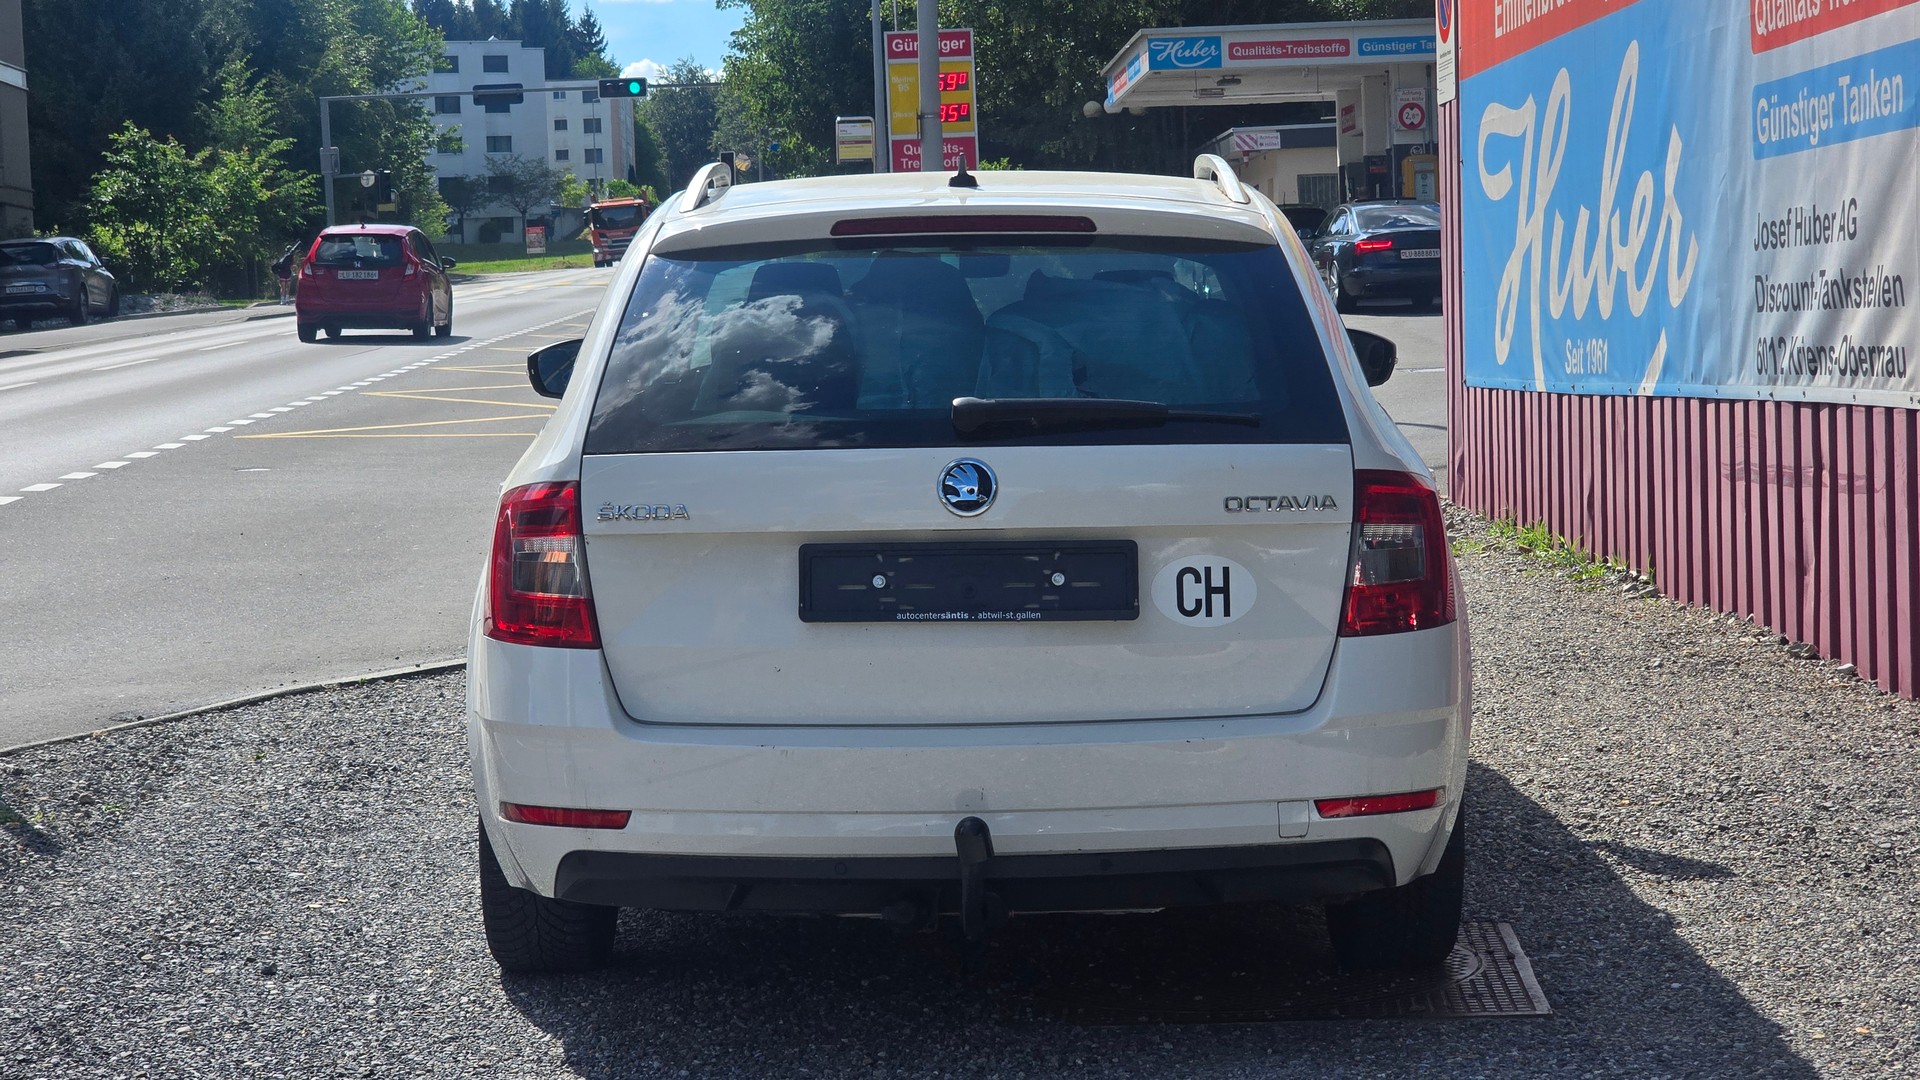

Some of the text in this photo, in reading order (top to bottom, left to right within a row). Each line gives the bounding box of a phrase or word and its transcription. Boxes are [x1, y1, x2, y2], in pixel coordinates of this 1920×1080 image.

[1150, 40, 1219, 67] Huber
[1233, 43, 1346, 56] Qualitäts-Treibstoffe
[1362, 41, 1417, 52] Günstiger
[1757, 68, 1903, 145] Günstiger Tanken
[1478, 40, 1698, 395] Huber
[1754, 197, 1858, 251] Josef Huber AG
[1755, 265, 1905, 313] Discount-Tankstellen
[1565, 338, 1608, 374] Seit 1961
[1756, 334, 1906, 378] 6012 Kriens-Obernau
[597, 502, 690, 521] ŠKODA
[1223, 495, 1339, 513] OCTAVIA
[1176, 566, 1231, 618] CH
[896, 611, 969, 620] autocentersäntis
[977, 611, 1041, 621] abtwil-st.gallen
